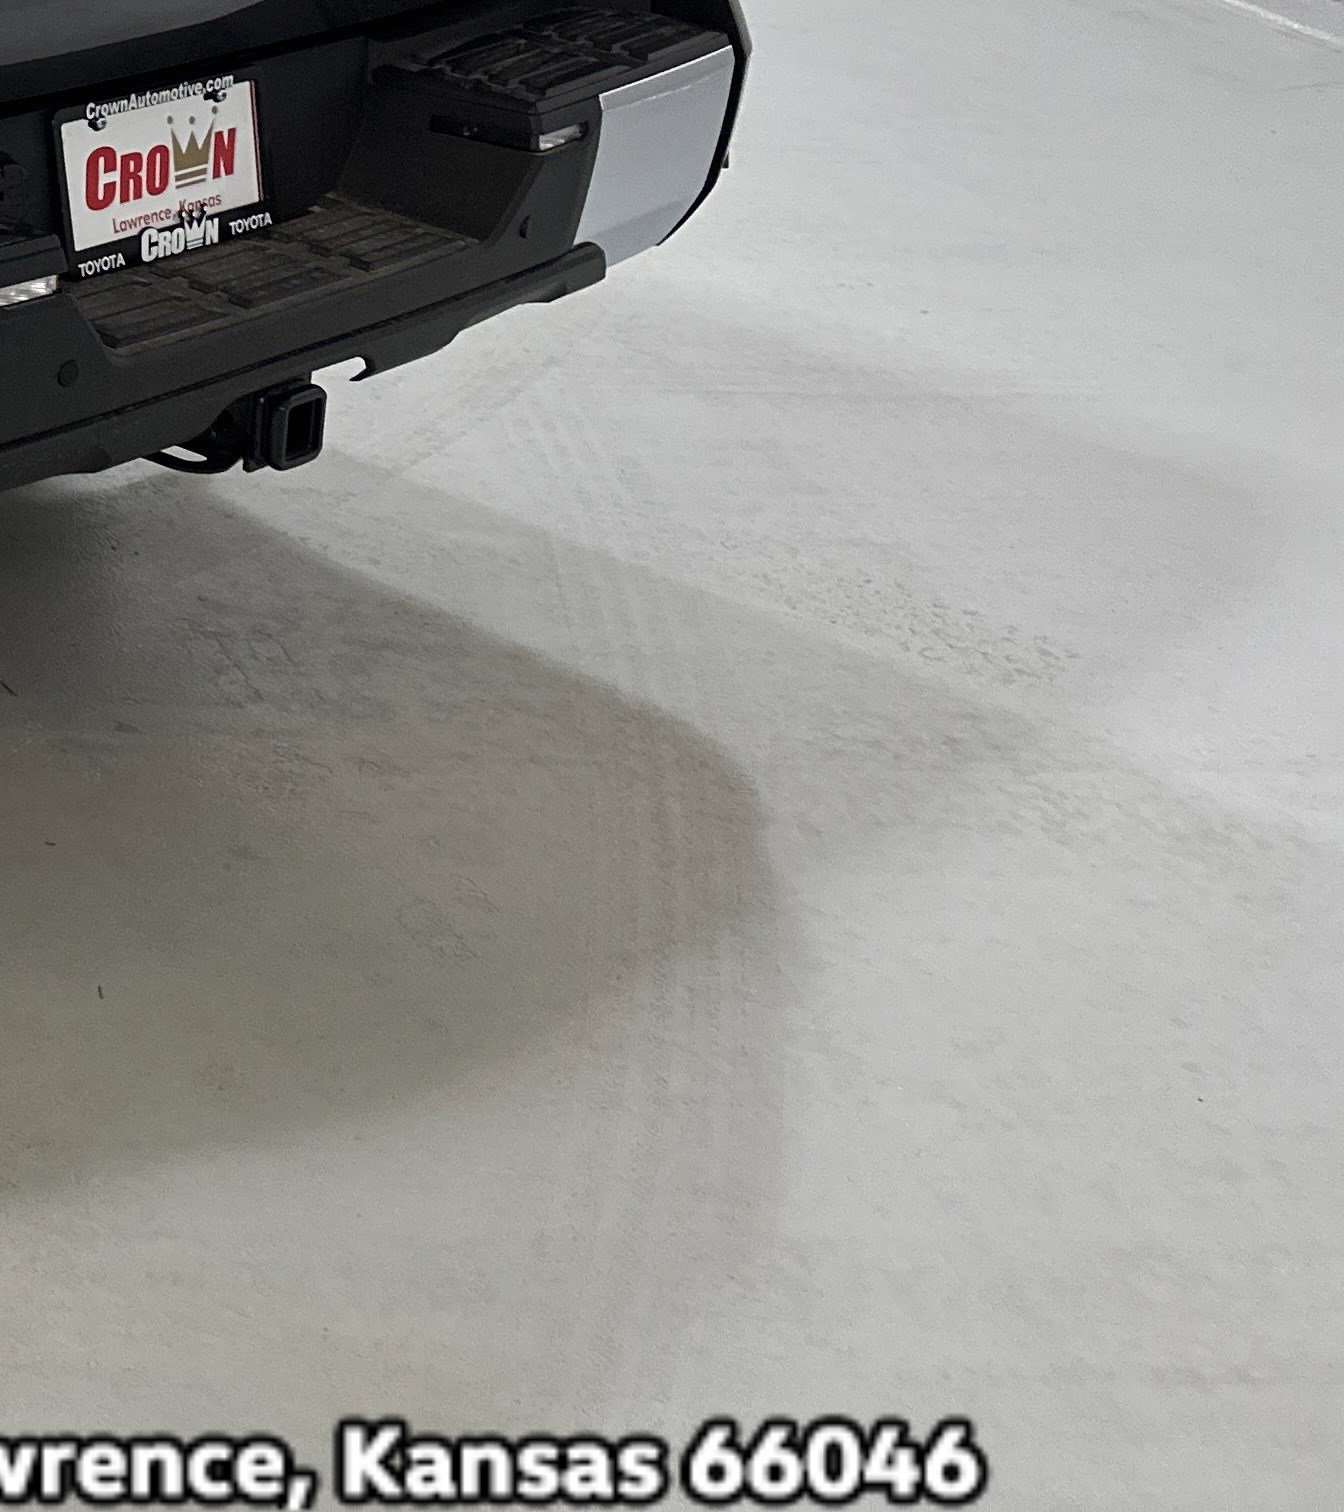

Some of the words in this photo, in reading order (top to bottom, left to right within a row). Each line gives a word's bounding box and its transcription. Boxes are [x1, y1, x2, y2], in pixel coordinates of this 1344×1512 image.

[85, 74, 234, 120] CrownAutomotive.com
[229, 212, 273, 236] TOYOTA
[78, 252, 126, 278] TOYOTA
